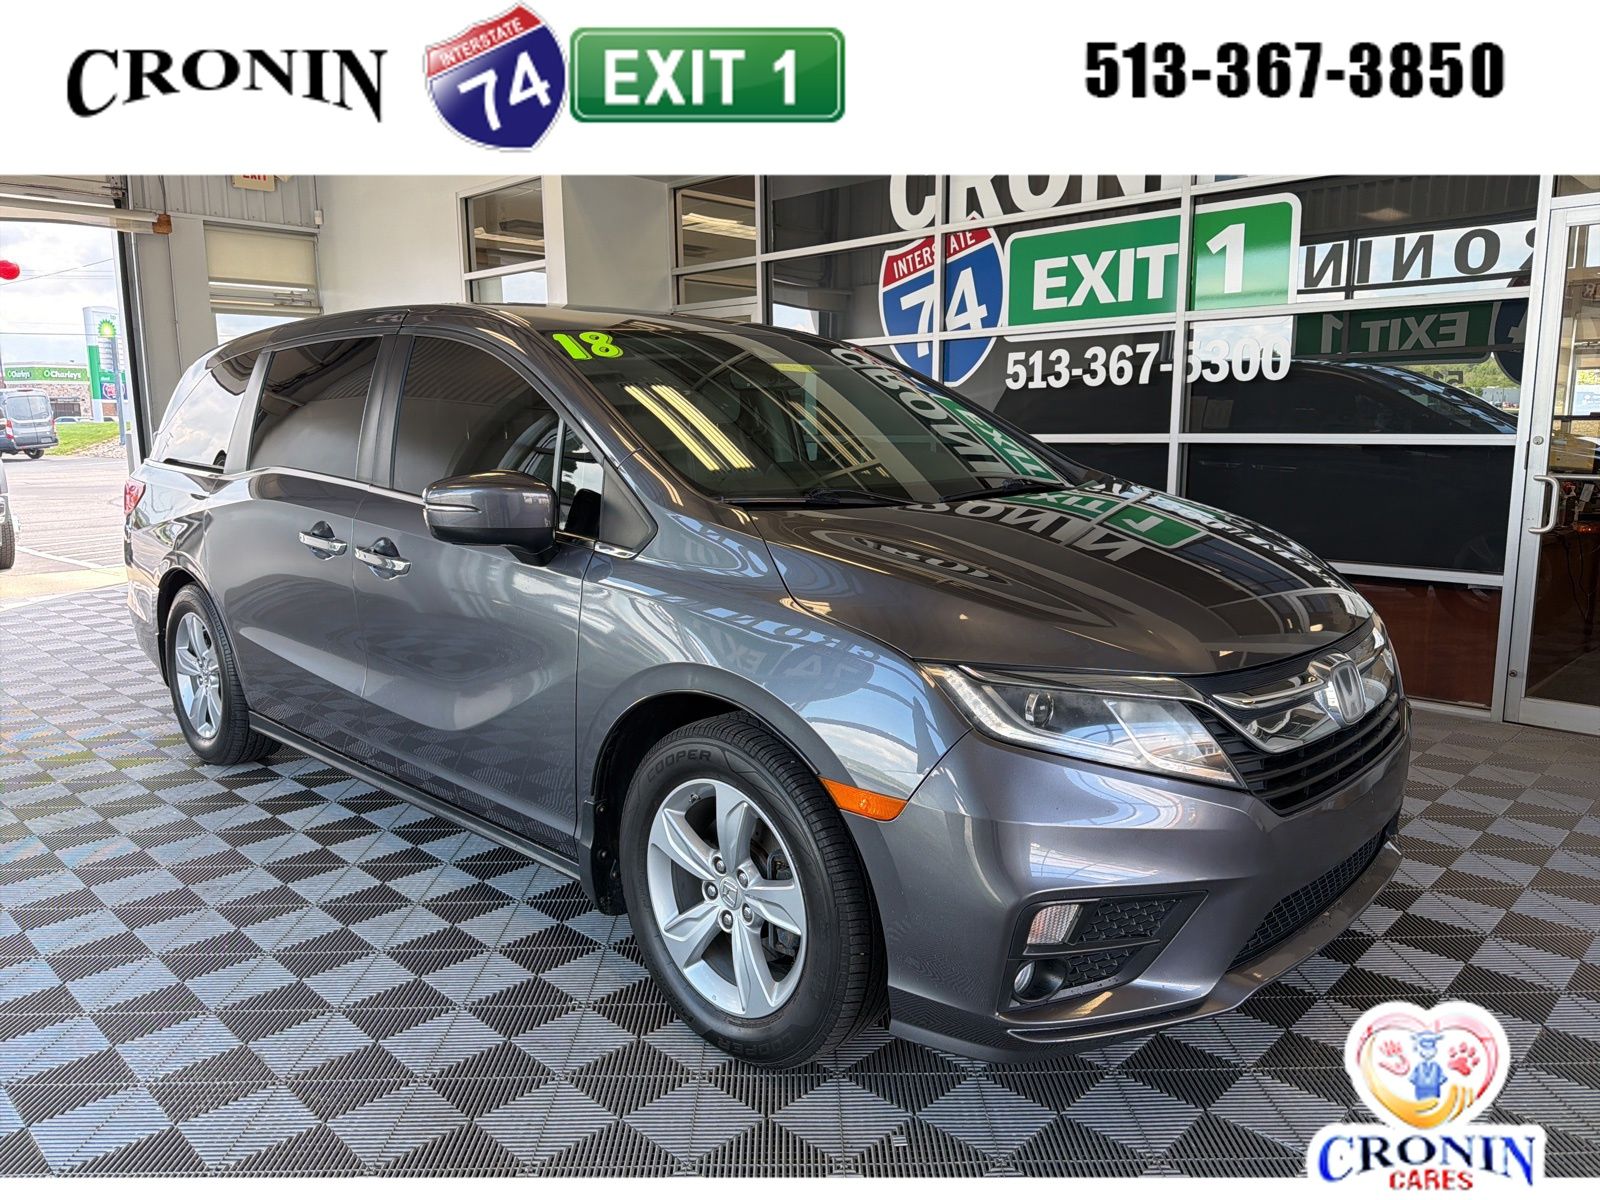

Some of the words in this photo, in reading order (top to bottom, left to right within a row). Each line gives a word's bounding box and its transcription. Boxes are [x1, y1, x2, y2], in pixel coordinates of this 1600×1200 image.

[893, 230, 976, 279] INTERSATE
[1032, 242, 1180, 311] EXIT
[1205, 222, 1246, 294] 1
[899, 267, 988, 358] 74
[552, 331, 624, 360] 18
[647, 749, 712, 783] COOPER
